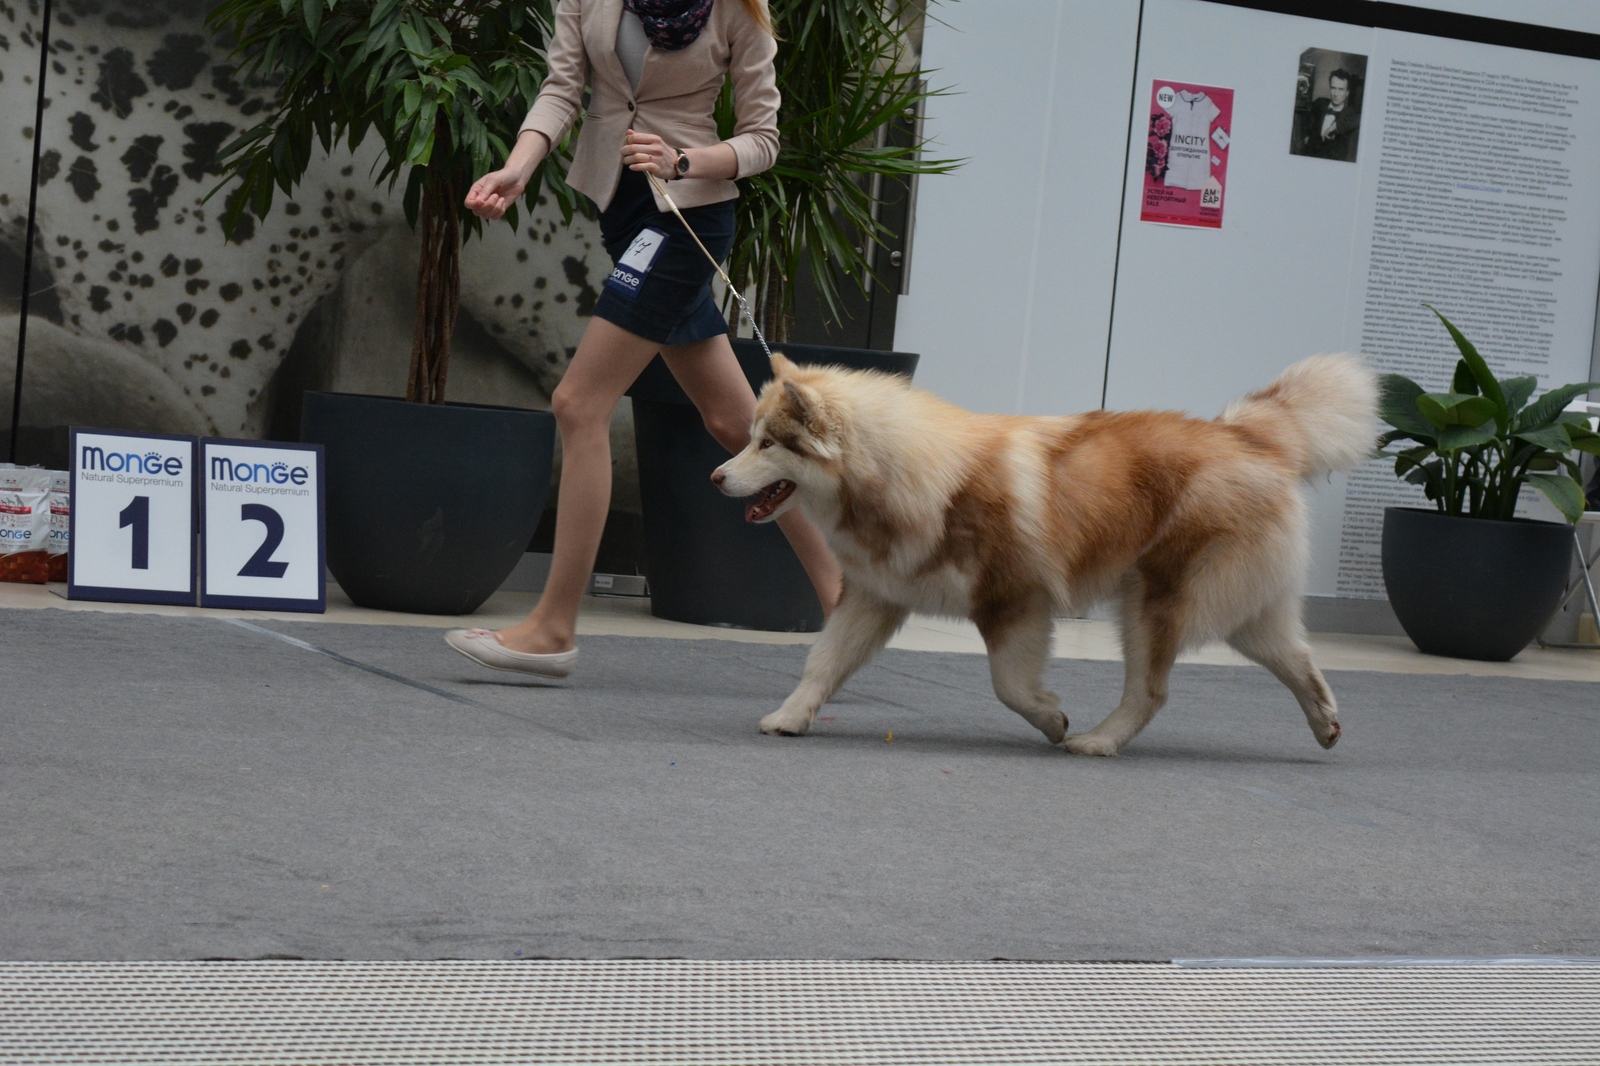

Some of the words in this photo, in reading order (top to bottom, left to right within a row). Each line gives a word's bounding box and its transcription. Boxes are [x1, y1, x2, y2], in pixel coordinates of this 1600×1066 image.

[1159, 93, 1174, 103] NEW
[1174, 134, 1206, 147] INCITY
[1202, 195, 1219, 205] БАР
[81, 471, 114, 483] Natural
[116, 474, 184, 488] Superpremium
[210, 482, 243, 493] Natural
[245, 484, 310, 497] Superpremium
[119, 495, 150, 570] 1
[236, 503, 290, 579] 2
